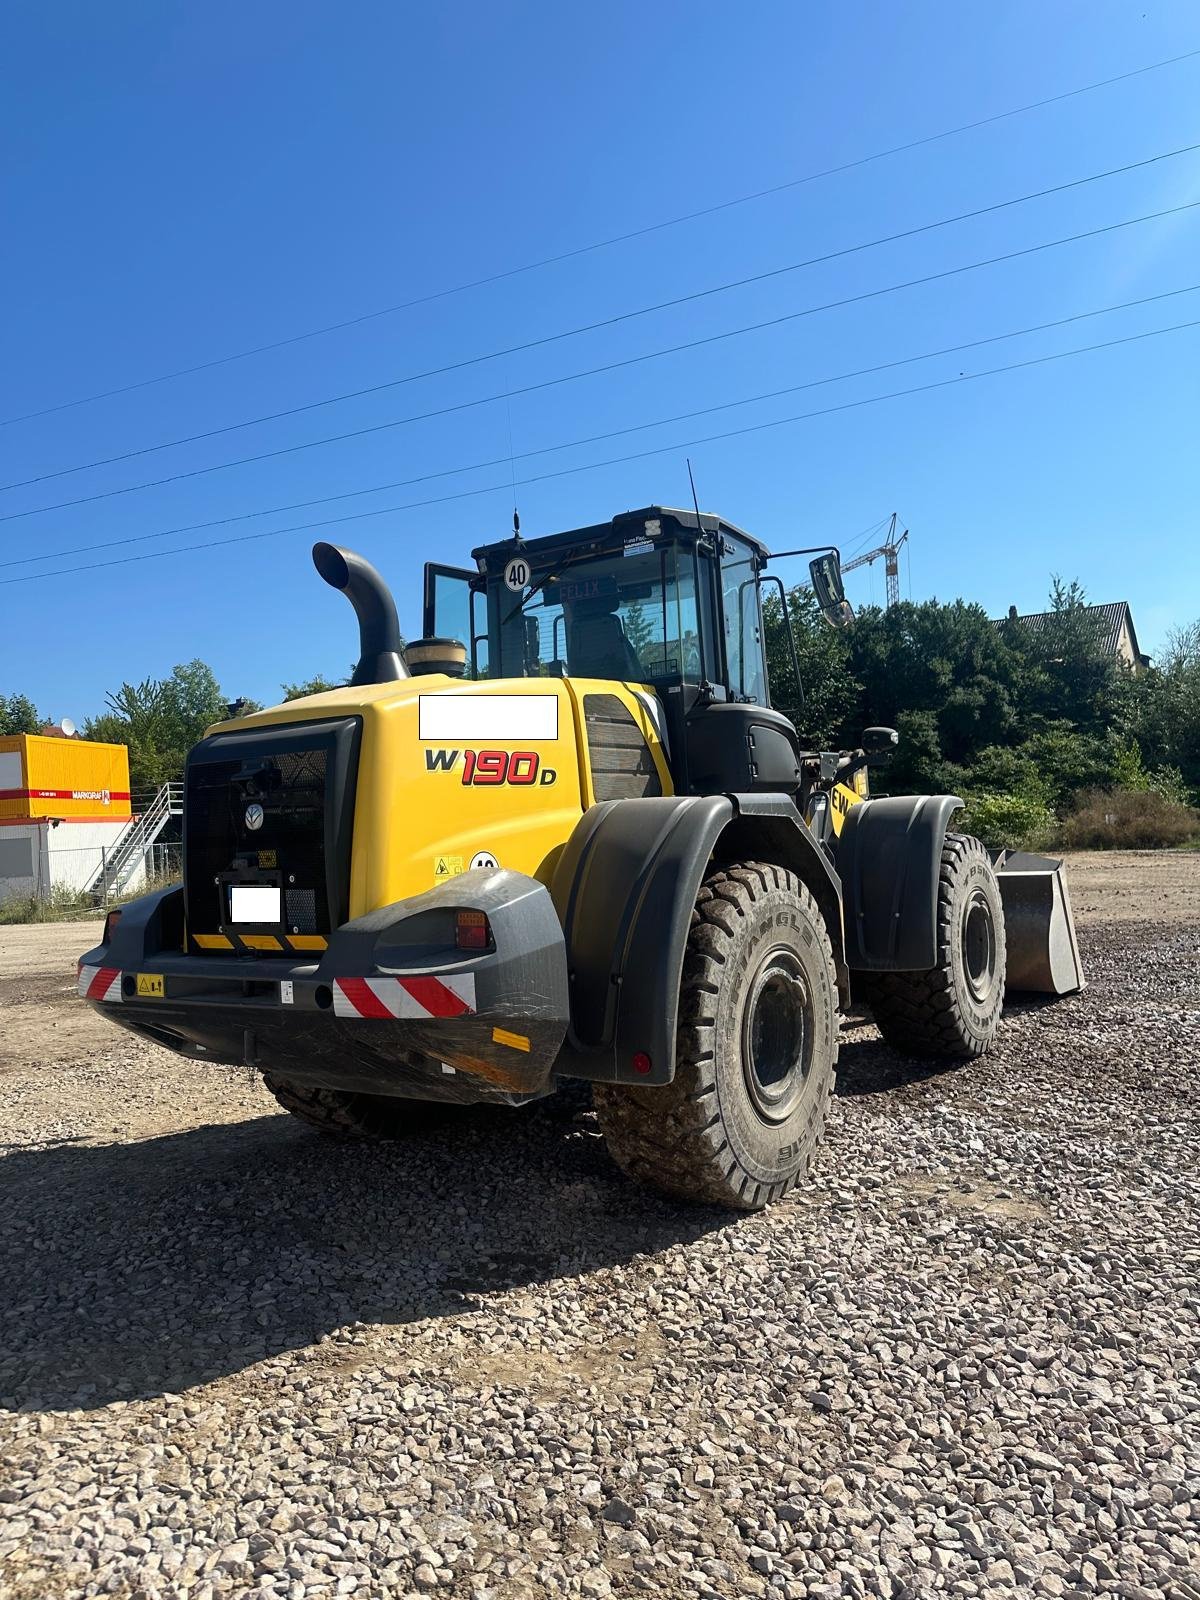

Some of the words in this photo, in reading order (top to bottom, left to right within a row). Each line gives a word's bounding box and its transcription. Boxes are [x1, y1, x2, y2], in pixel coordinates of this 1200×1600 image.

[509, 564, 526, 586] 40
[560, 580, 600, 600] FELIX
[831, 787, 849, 817] EW
